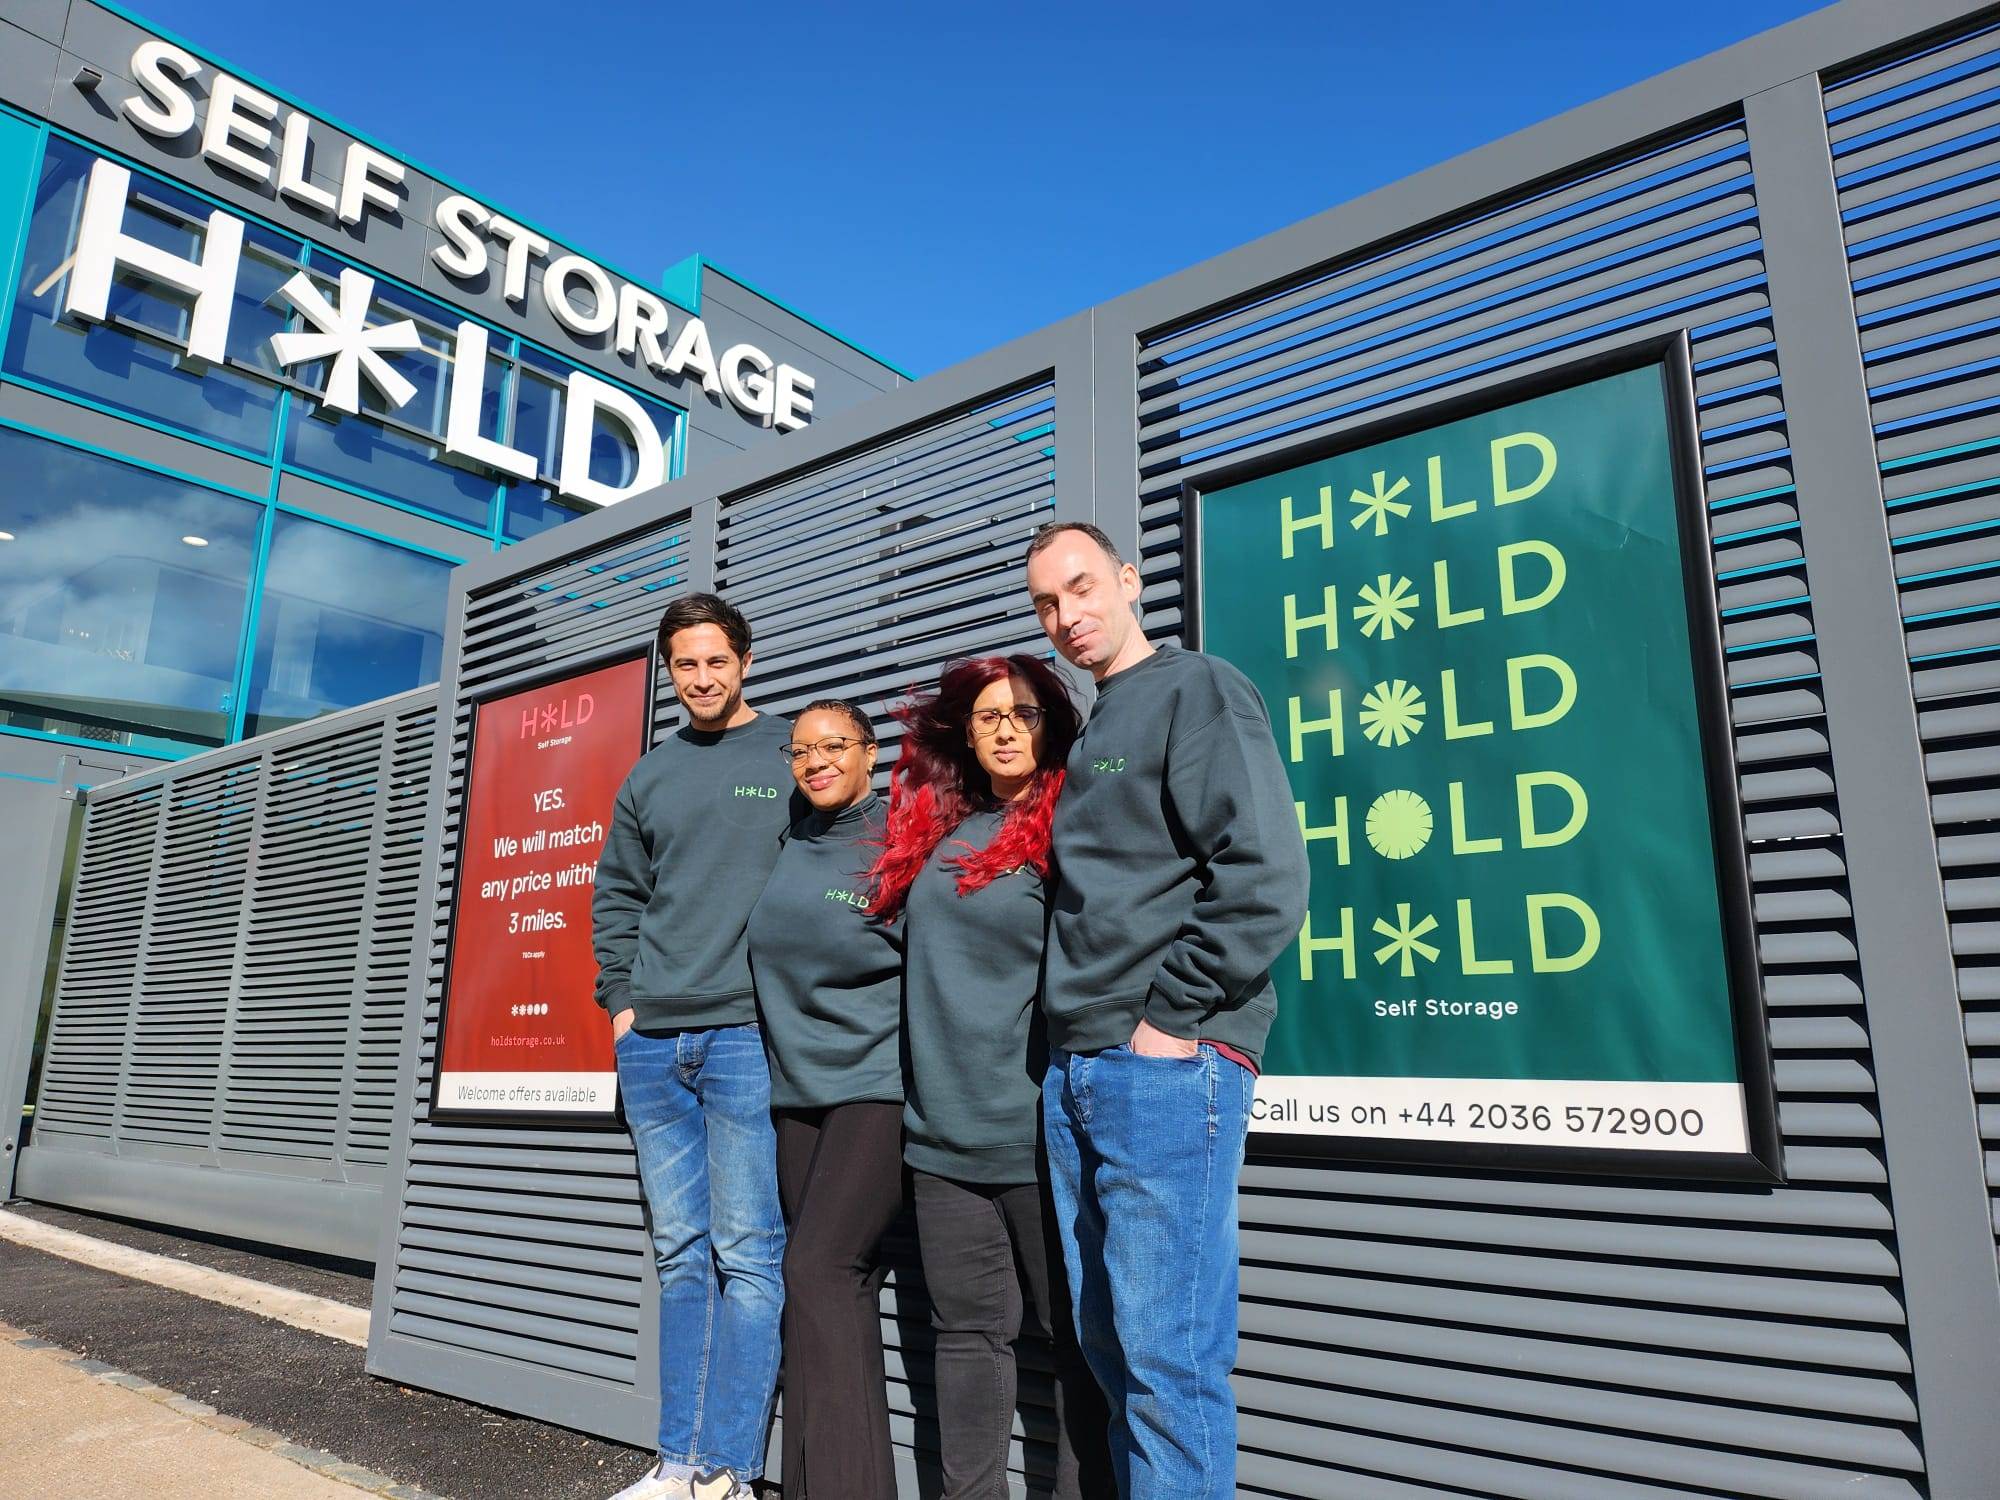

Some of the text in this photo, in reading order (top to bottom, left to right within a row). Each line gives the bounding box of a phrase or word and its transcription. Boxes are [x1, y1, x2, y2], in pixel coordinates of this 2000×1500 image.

[121, 41, 816, 432] SELF STORAGE
[533, 788, 566, 813] YES.
[493, 820, 603, 858] We will match
[481, 860, 598, 901] any price withi
[508, 909, 567, 934] 3 miles.
[1374, 999, 1519, 1019] Self Storage
[491, 1034, 566, 1048] holdstorage.co.uk
[458, 1086, 597, 1103] Welcome offers available
[1250, 1097, 1704, 1137] Call us on +44 2036 572900
